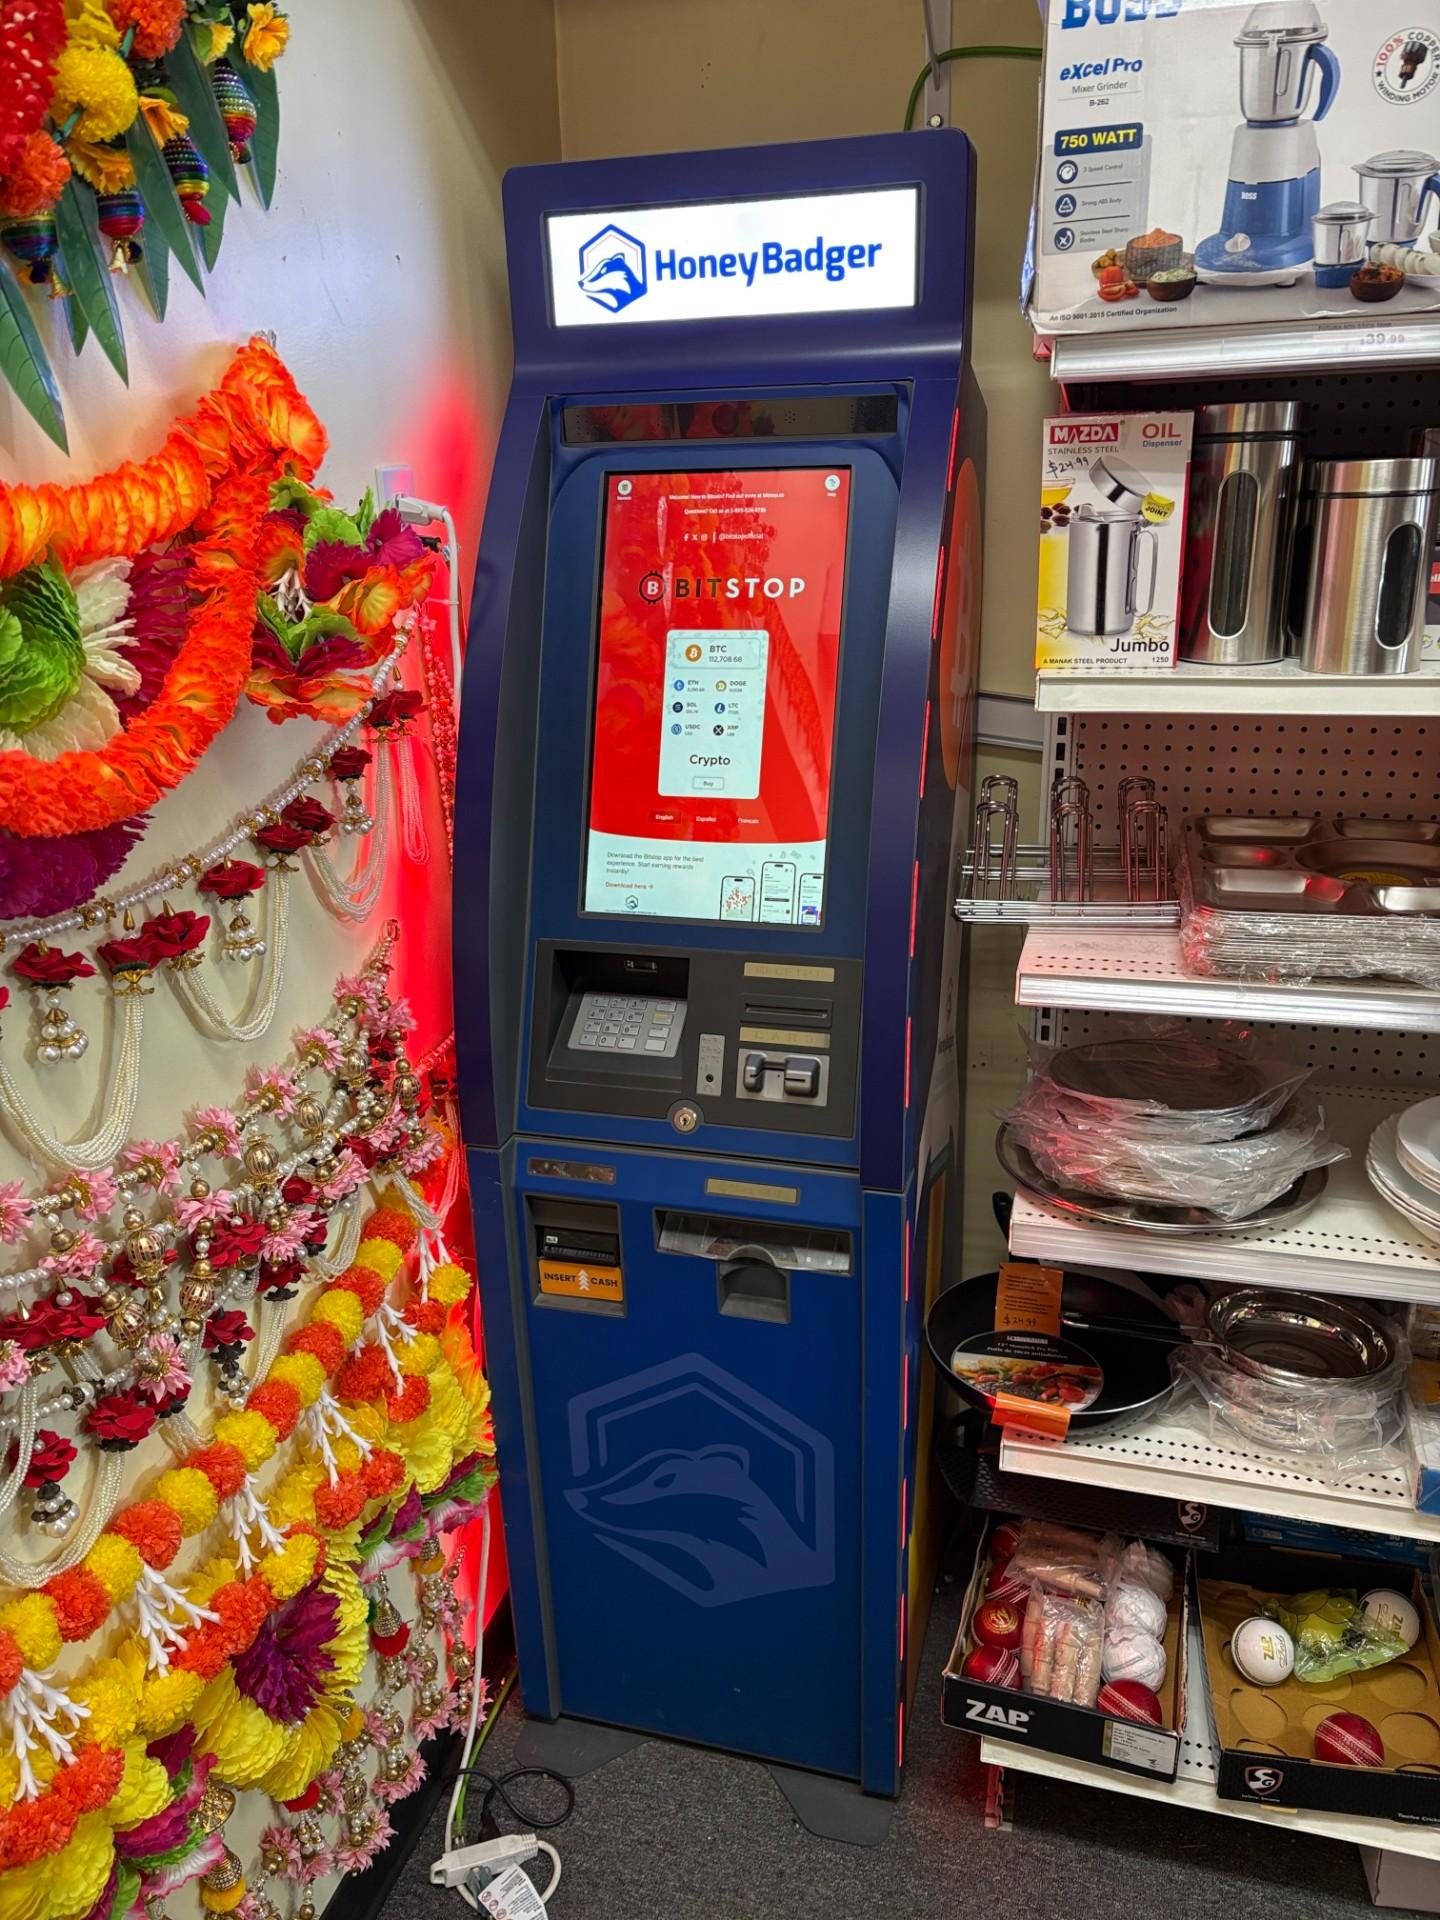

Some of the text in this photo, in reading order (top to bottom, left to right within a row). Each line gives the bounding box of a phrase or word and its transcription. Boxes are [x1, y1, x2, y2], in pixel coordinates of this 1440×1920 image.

[1376, 35, 1404, 67] 100%
[1060, 58, 1143, 81] eXcel Pro
[1072, 80, 1128, 94] Mixer Grinder
[1377, 72, 1439, 102] WINDING MOTOR
[1060, 129, 1137, 150] 750 WATT
[655, 236, 882, 287] HoneyBadger
[1072, 312, 1105, 320] 9001:2015
[1106, 309, 1134, 318] Certified
[1135, 306, 1177, 316] Organization
[1054, 426, 1116, 444] MAZDA
[1142, 422, 1182, 440] OIL
[1142, 439, 1182, 449] Dispenser
[1145, 506, 1168, 518] JOINT
[674, 578, 805, 598] BITSTOP
[1110, 638, 1169, 652] Jumbo
[689, 754, 730, 767] Crypto
[544, 1272, 618, 1287] INSERT CASH
[966, 1698, 1030, 1731] ZAP
